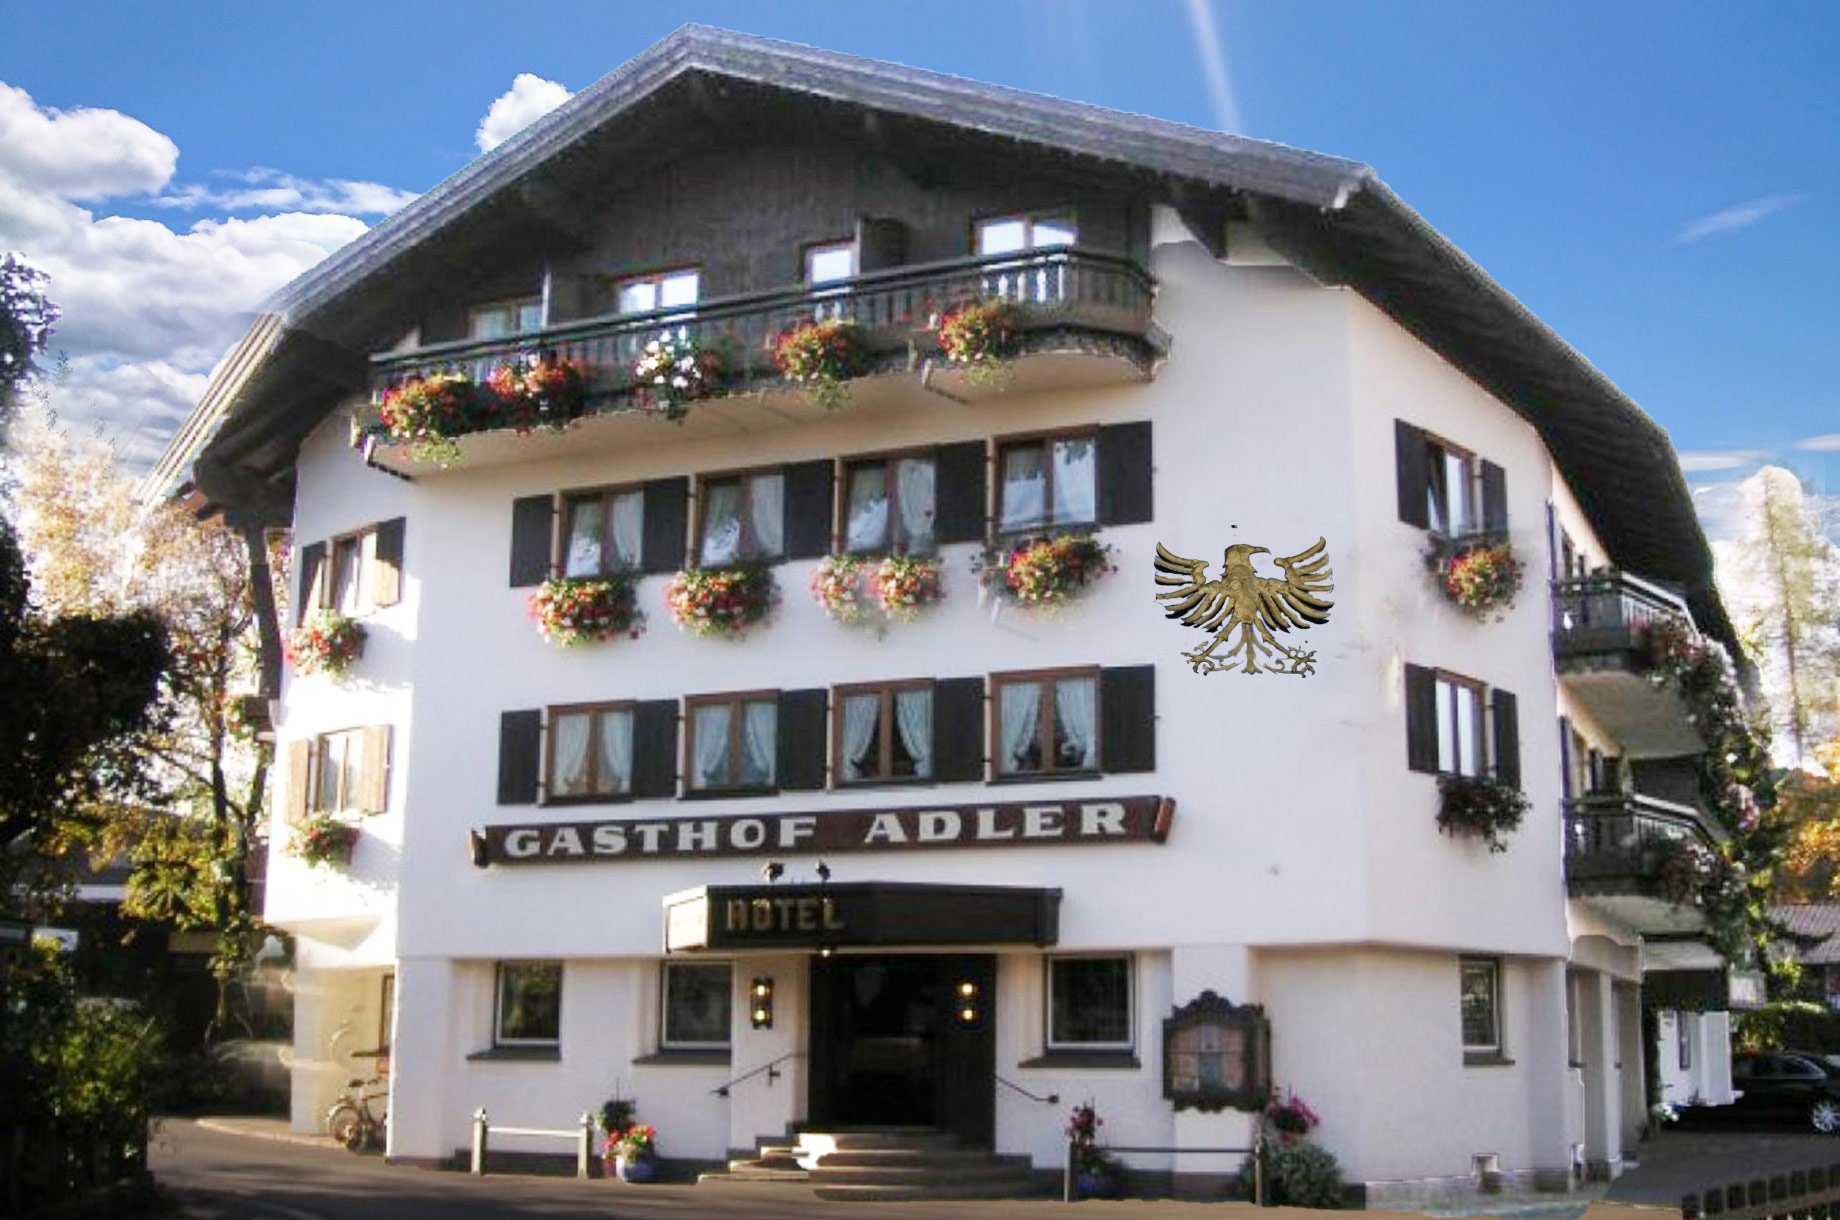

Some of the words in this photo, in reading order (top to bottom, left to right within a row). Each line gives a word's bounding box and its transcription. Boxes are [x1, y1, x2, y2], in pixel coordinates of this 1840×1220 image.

[504, 816, 817, 857] GASTHOF
[864, 802, 1126, 843] ADLER
[727, 898, 845, 931] HOTEL
